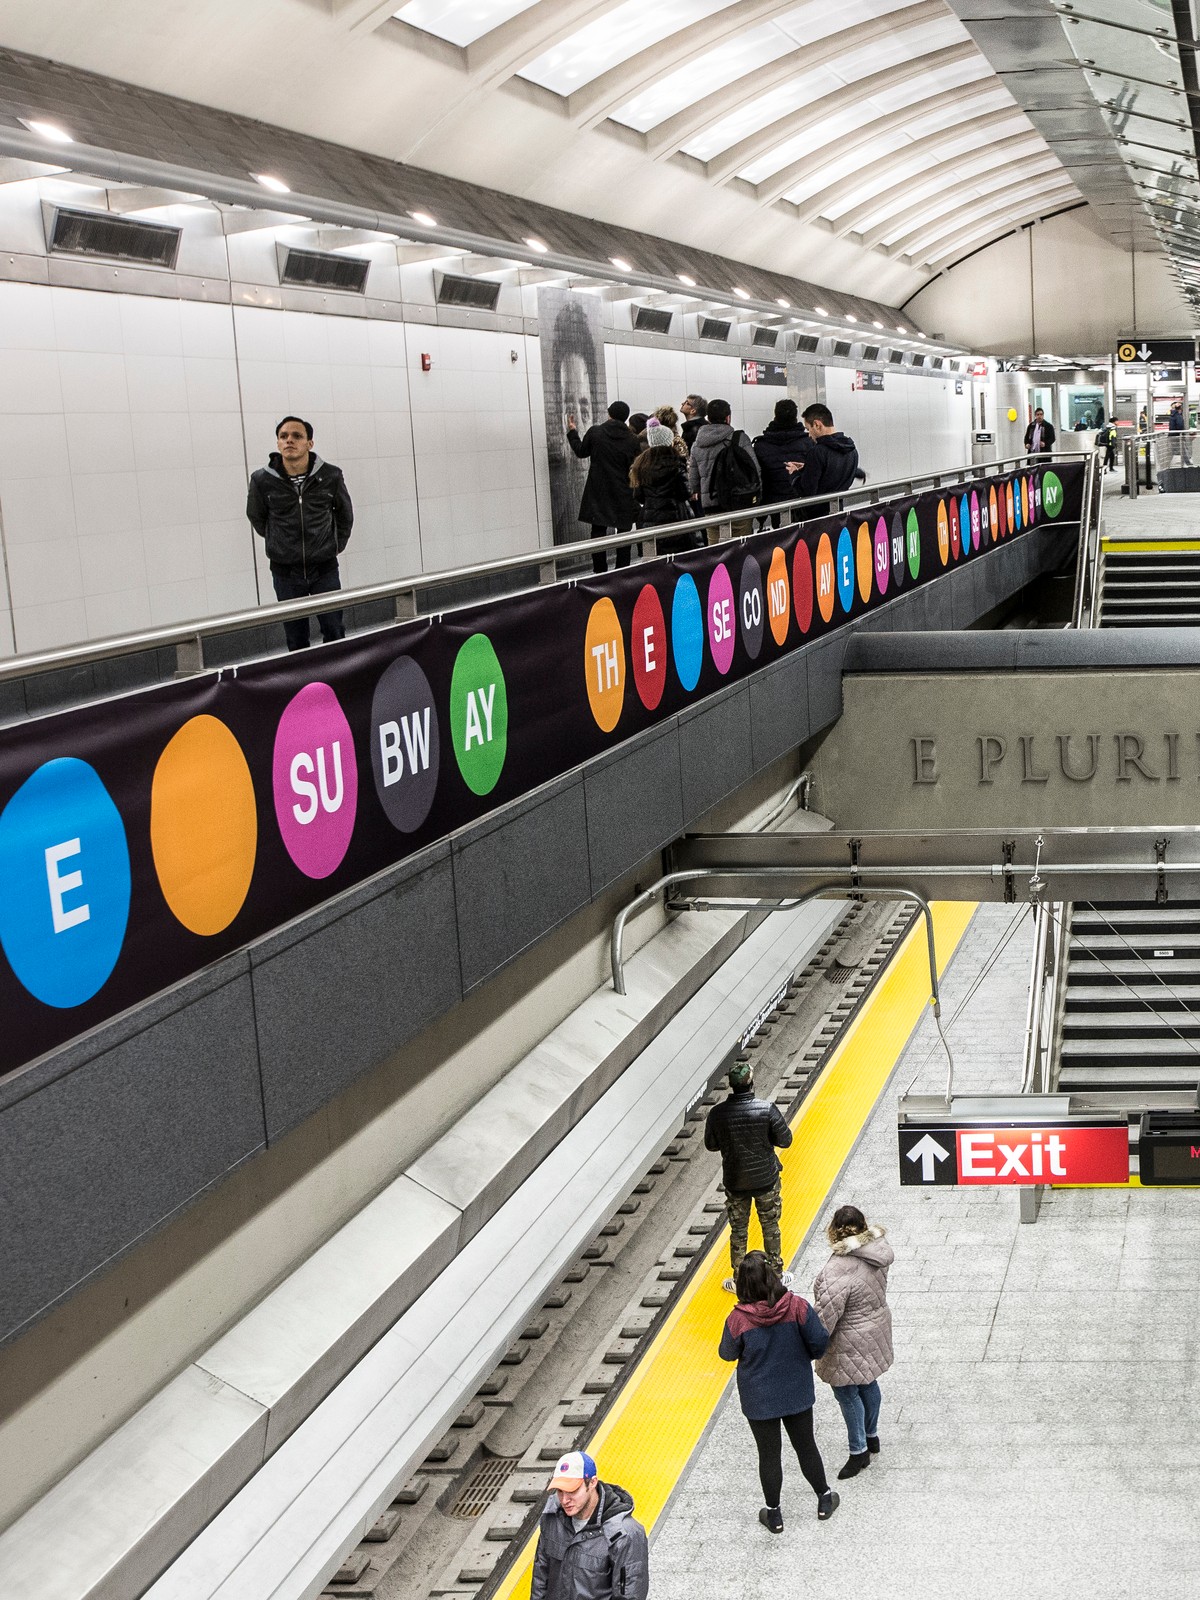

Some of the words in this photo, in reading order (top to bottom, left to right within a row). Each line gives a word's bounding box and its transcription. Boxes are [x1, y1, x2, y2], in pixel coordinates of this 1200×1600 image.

[1122, 347, 1132, 358] Q
[1046, 486, 1057, 505] AY
[591, 639, 619, 693] TH
[643, 625, 656, 673] E
[712, 598, 732, 643] SE
[743, 588, 761, 630] CO
[770, 579, 787, 618] ND
[820, 562, 831, 597] AV
[842, 555, 850, 587] E
[876, 541, 888, 572] SU
[892, 535, 904, 566] BW
[909, 530, 918, 559] AY
[909, 735, 940, 783] E
[44, 837, 91, 934] E
[289, 740, 344, 825] SU
[378, 706, 431, 788] BW
[465, 683, 496, 752] AY
[960, 1133, 1067, 1177] Exit
